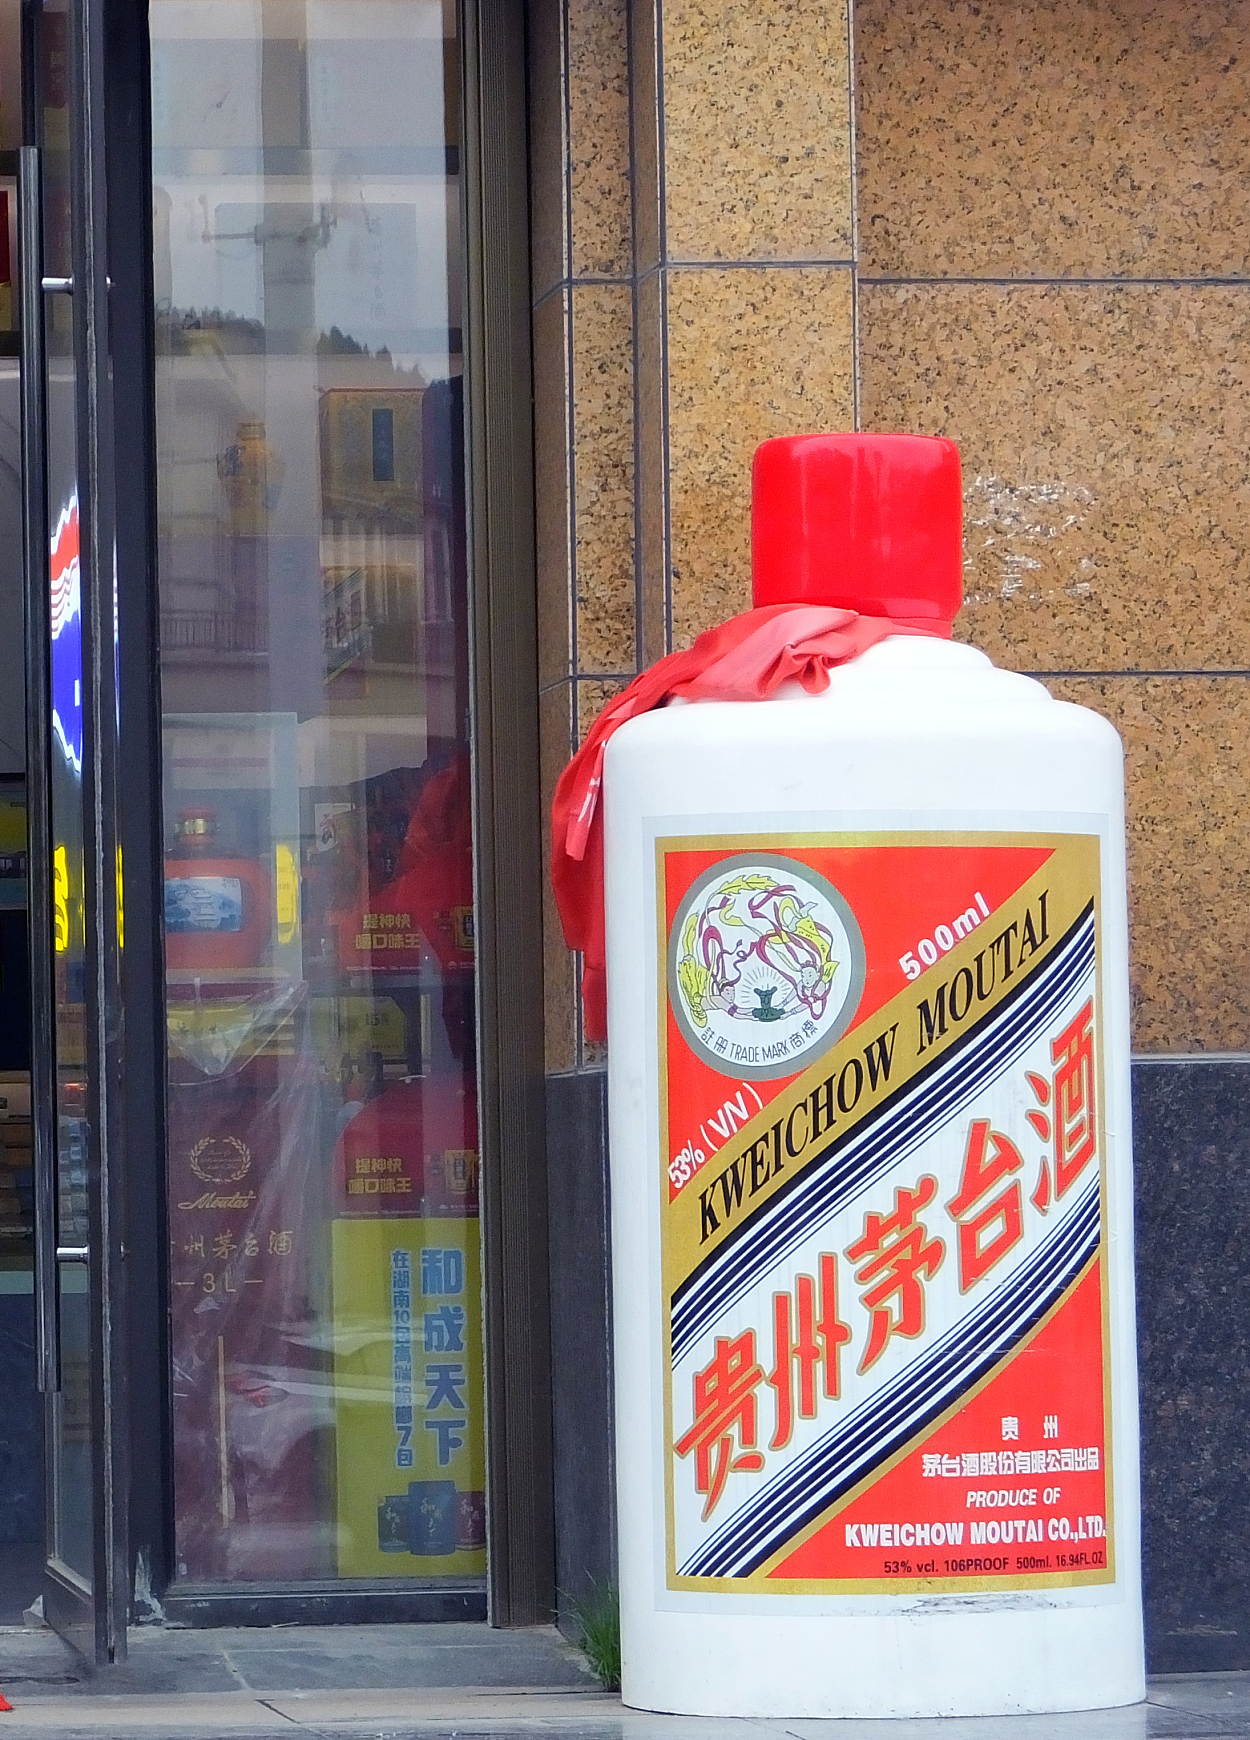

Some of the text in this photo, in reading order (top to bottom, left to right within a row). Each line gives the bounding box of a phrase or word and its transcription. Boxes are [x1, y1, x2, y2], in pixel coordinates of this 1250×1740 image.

[898, 892, 991, 981] 500ml
[697, 889, 1051, 1245] KWEICHOW MOUTAI
[729, 1043, 760, 1062] TRADE
[761, 1042, 790, 1062] MARK
[667, 1139, 705, 1189] 53%
[177, 1189, 257, 1210] Moutai
[170, 1229, 293, 1259] 州茅台酒
[674, 995, 1094, 1521] 贵州茅台酒
[421, 1249, 466, 1465] 和成天下
[922, 1447, 1099, 1477] 茅台酒股份有限公司出品
[966, 1487, 1061, 1508] PRODUCE OF
[845, 1522, 964, 1548] KWEICHOW
[970, 1519, 1043, 1545] MOUTAI
[884, 1559, 912, 1574] 53%
[944, 1557, 1010, 1572] 106PROOF
[1016, 1555, 1052, 1570] 500ml.
